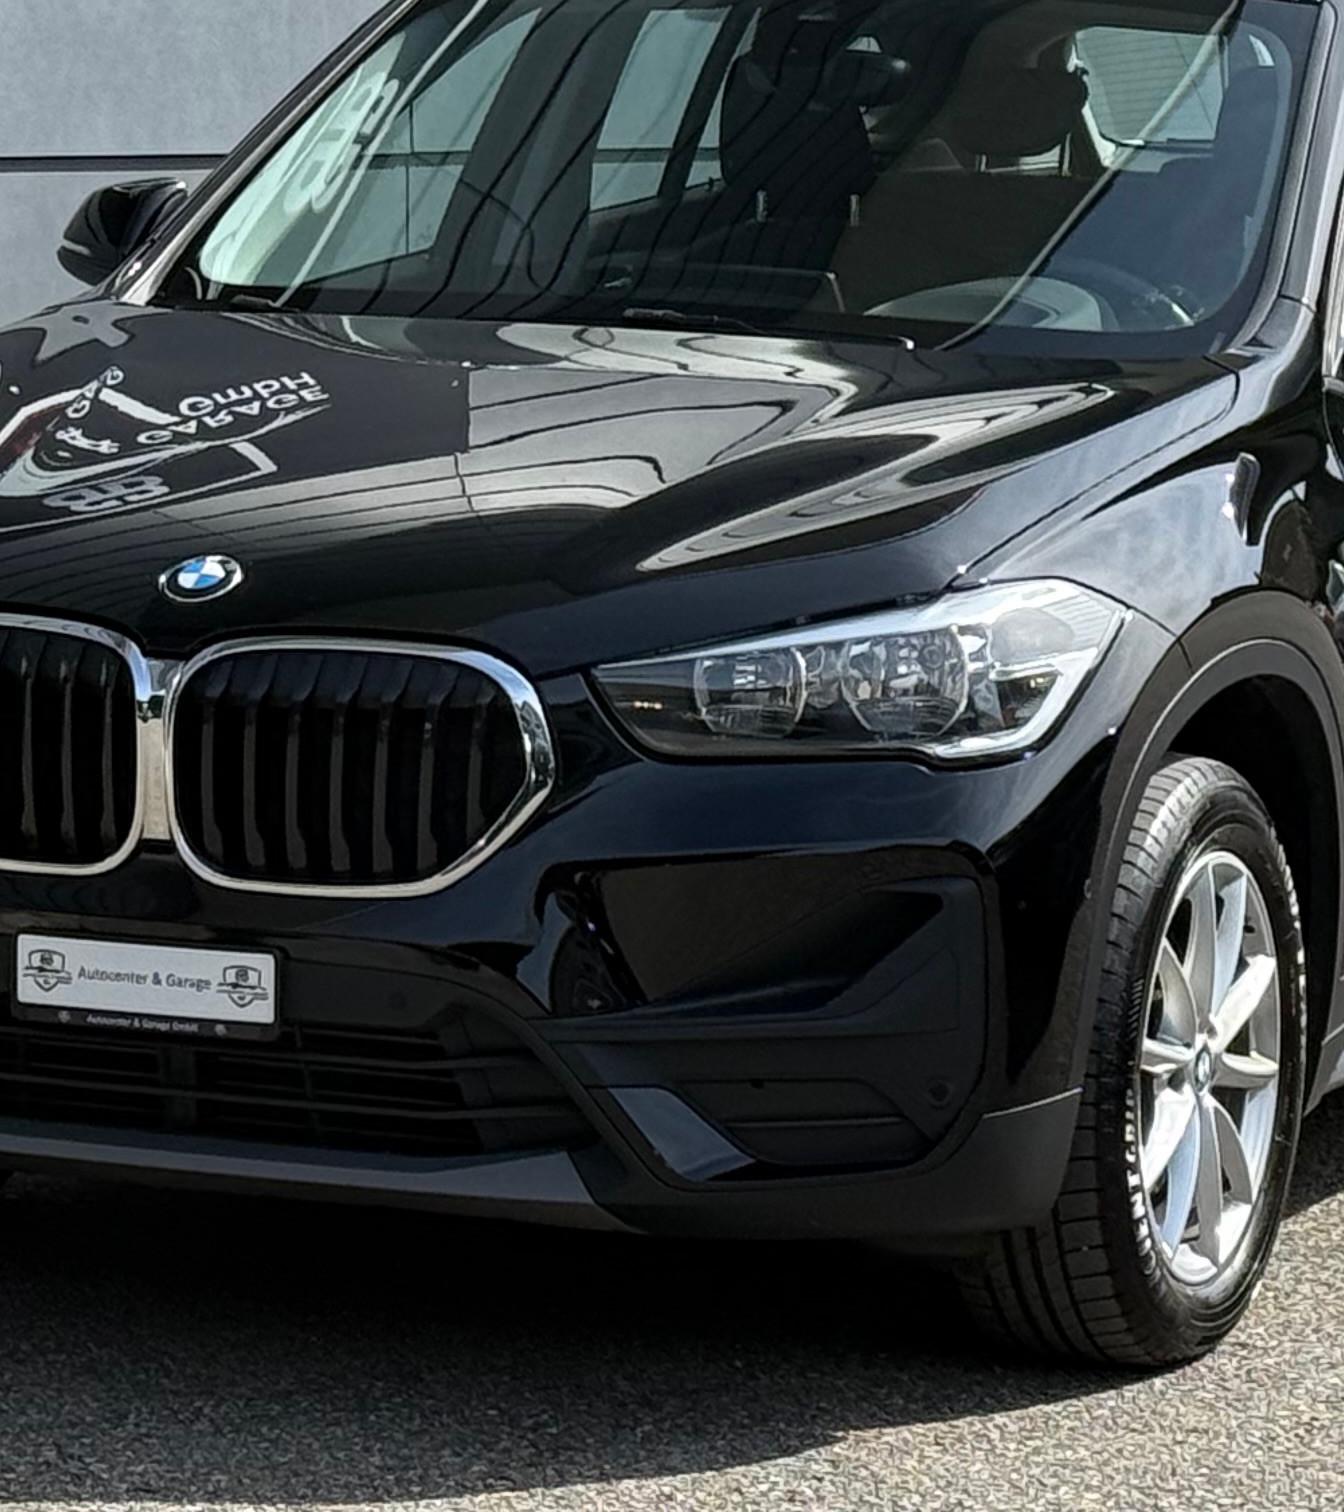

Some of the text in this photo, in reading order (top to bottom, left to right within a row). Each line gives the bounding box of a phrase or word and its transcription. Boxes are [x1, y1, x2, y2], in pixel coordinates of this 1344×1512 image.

[78, 965, 148, 985] Autocenter
[152, 971, 162, 986] &
[166, 973, 212, 992] Garage
